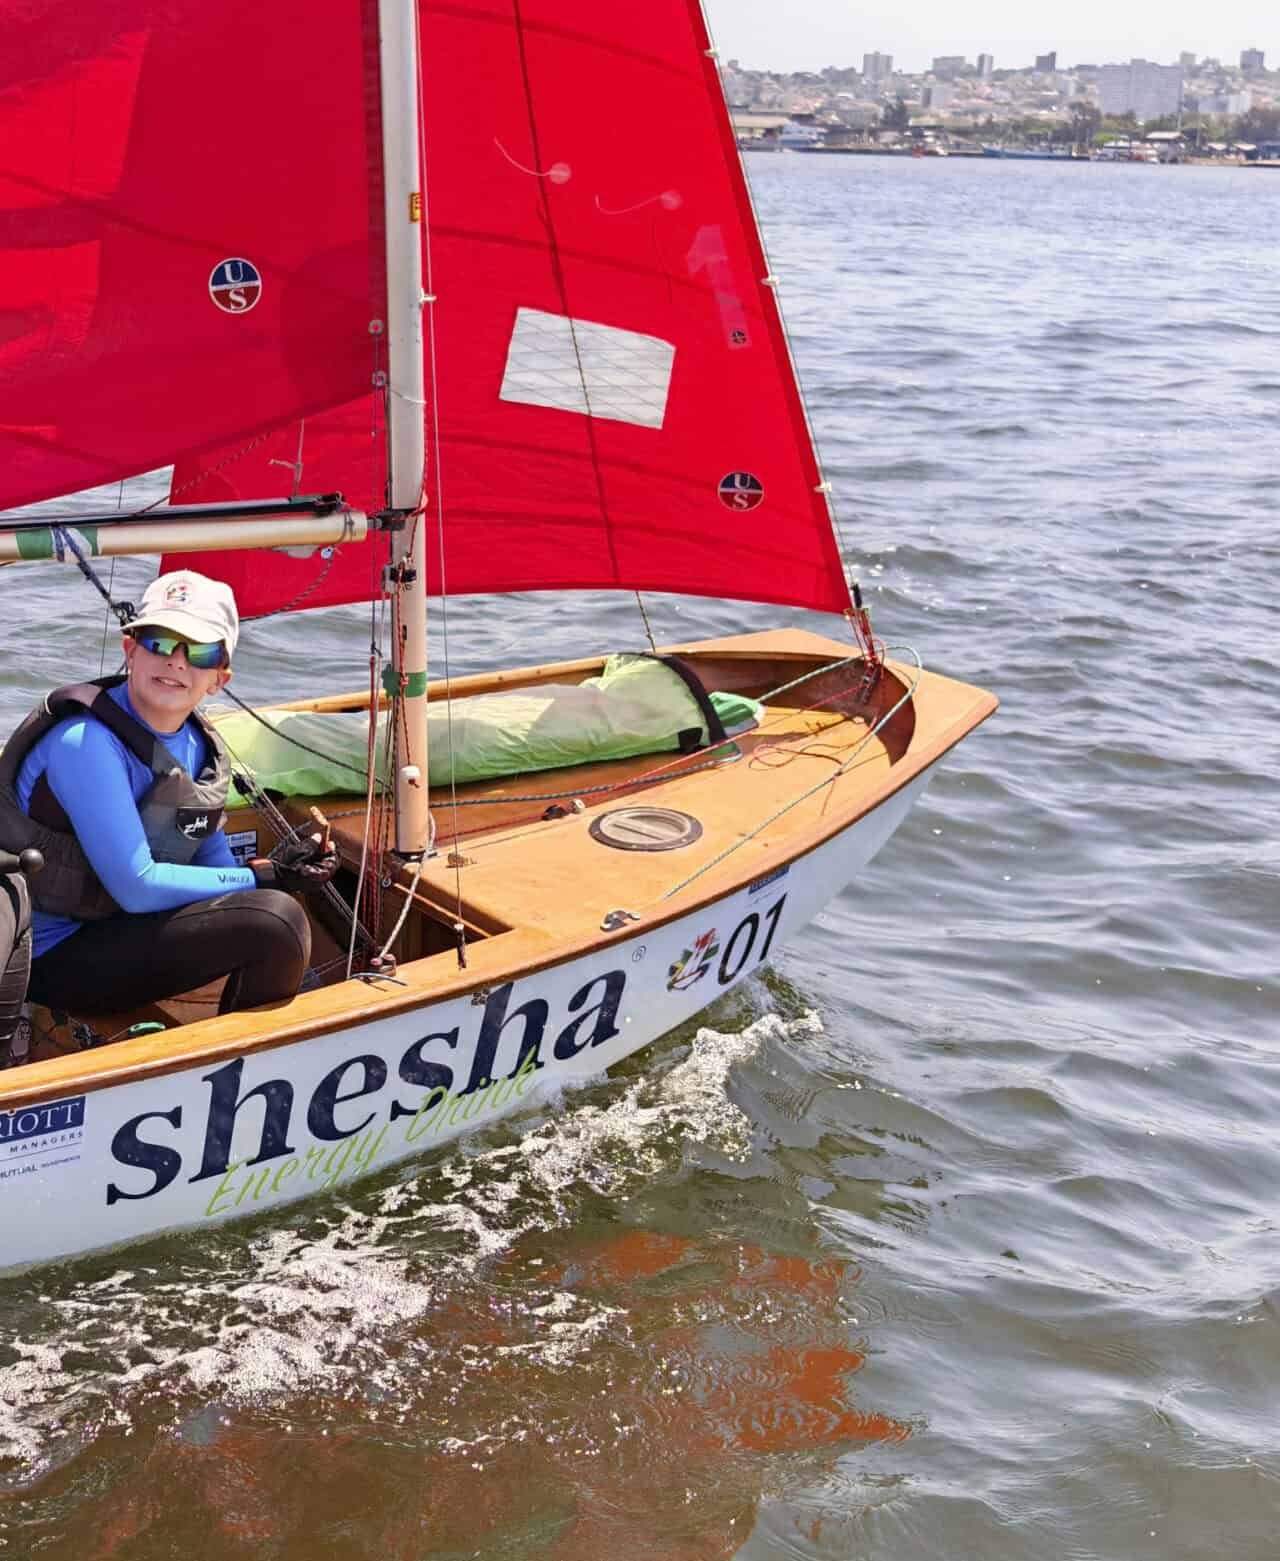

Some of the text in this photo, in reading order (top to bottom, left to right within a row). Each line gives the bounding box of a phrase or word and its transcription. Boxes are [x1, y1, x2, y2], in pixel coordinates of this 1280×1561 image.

[717, 892, 788, 986] 01
[9, 1130, 84, 1153] MANAGERS
[106, 969, 627, 1206] shesha
[205, 1044, 538, 1218] Energy Drink
